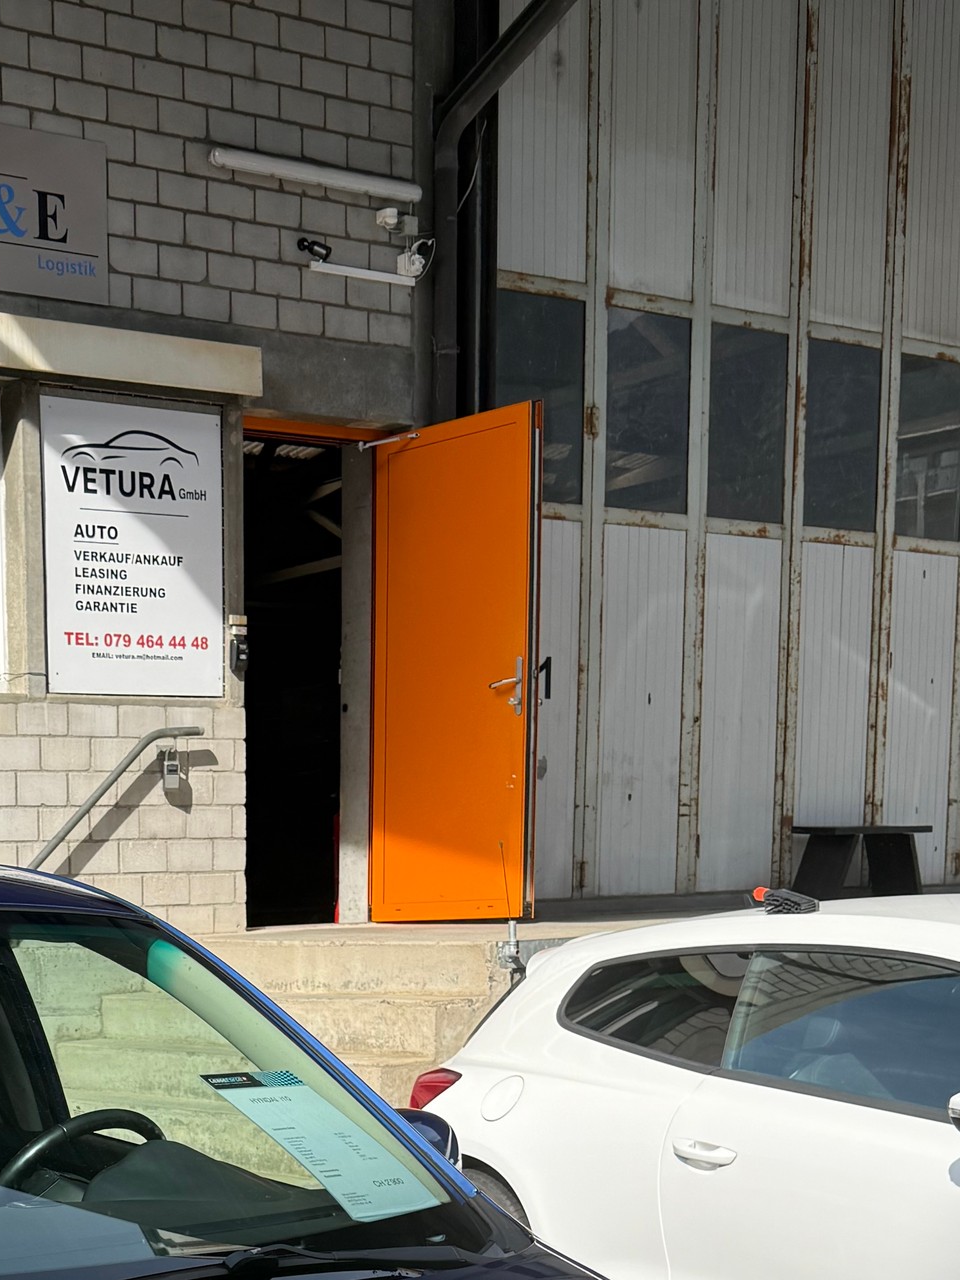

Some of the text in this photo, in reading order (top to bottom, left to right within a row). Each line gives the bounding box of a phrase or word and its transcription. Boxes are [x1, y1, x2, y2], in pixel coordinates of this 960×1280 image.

[37, 255, 97, 278] Logistik
[60, 464, 207, 501] VETURA GmbH
[73, 523, 119, 540] AUTO
[73, 549, 184, 567] VERKAUF/ANKAUF
[74, 566, 128, 580] LEASING
[75, 584, 166, 599] FINANZIERUNG
[75, 600, 138, 614] GARANTIE
[64, 631, 209, 651] TEL: 079 464 44 48
